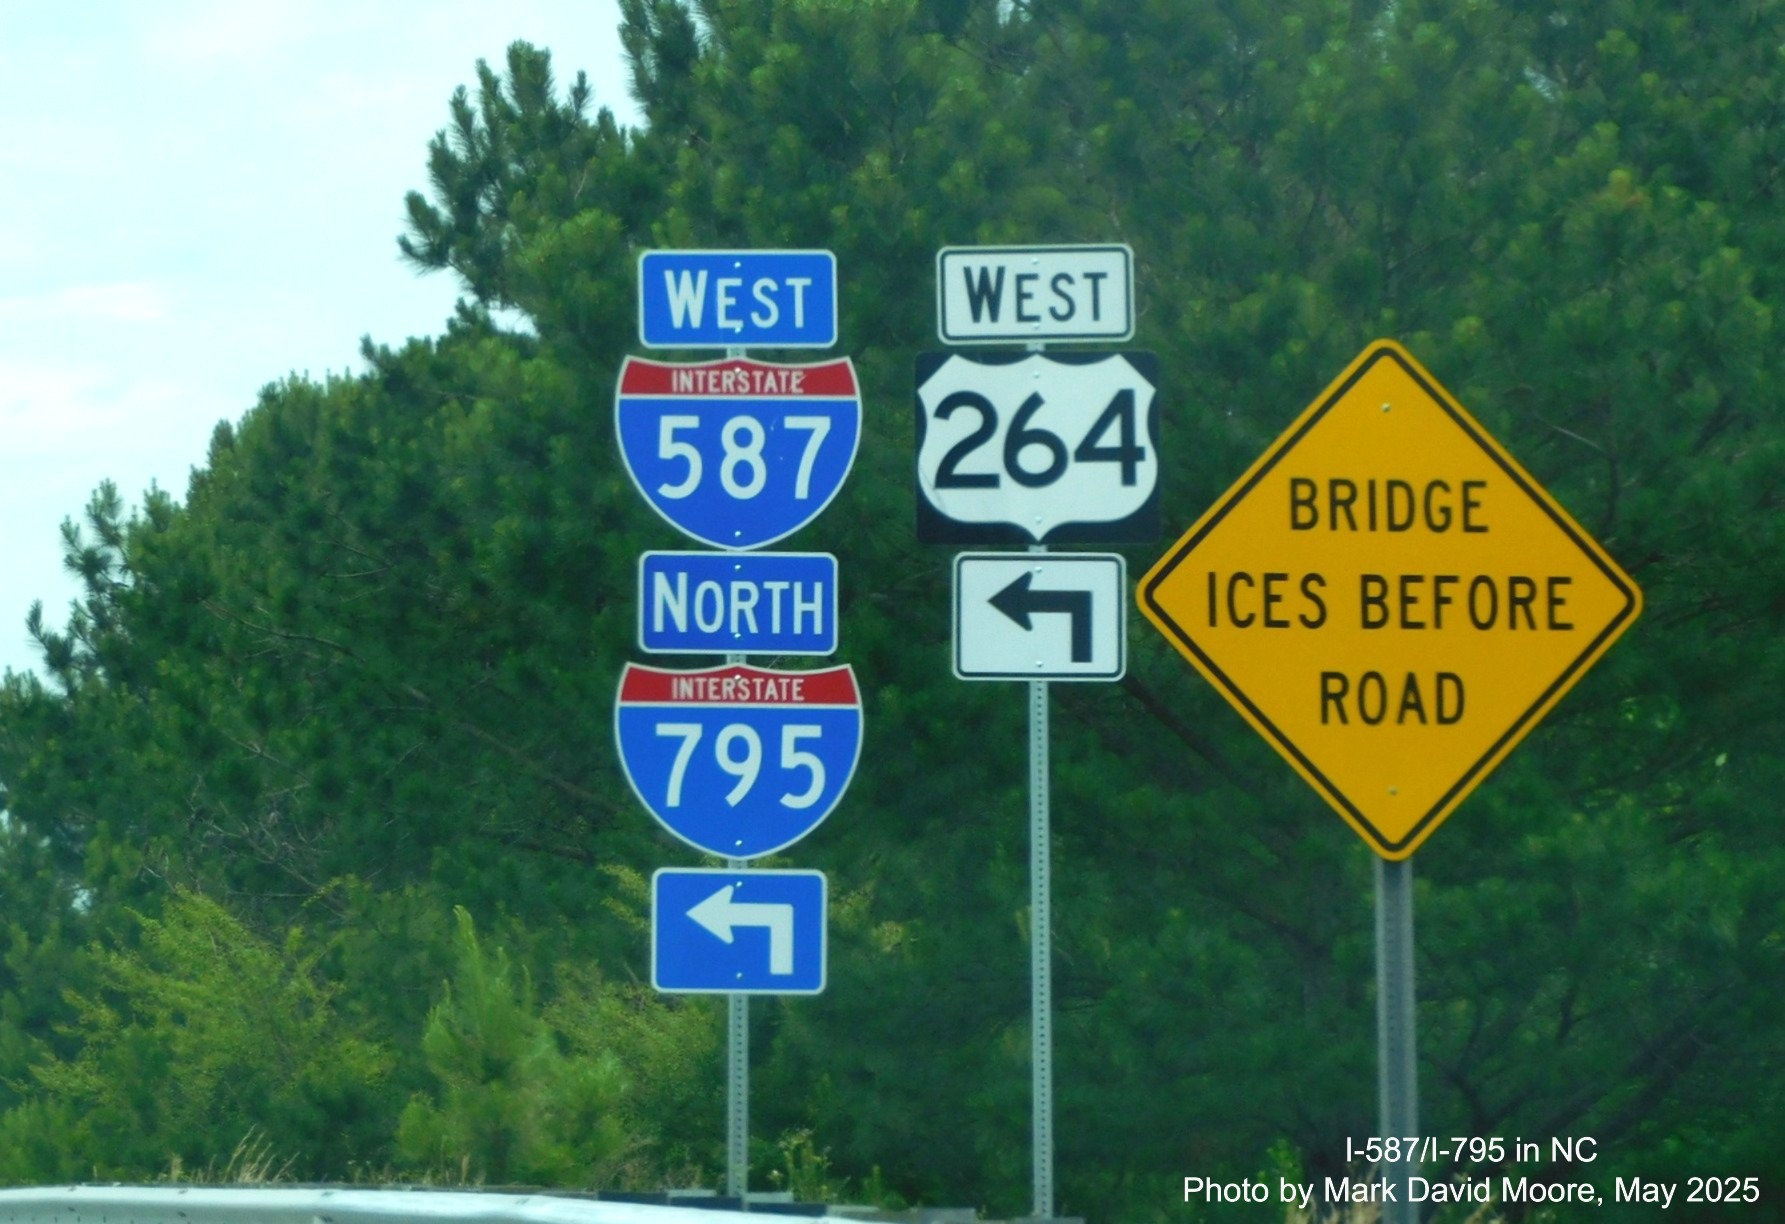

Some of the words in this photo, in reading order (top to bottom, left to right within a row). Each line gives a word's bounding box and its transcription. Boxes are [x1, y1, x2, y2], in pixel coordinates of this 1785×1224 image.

[664, 269, 812, 329] WEST
[963, 266, 1108, 324] WEST
[671, 369, 804, 394] INTERSTATE
[657, 415, 831, 500] 587
[933, 388, 1146, 490] 264
[1289, 477, 1489, 533] BRIDGE
[653, 572, 823, 636] NORTH
[1208, 571, 1328, 629] ICES
[1360, 573, 1575, 632] BEFORE
[671, 677, 805, 702] INTERSTATE
[1320, 670, 1466, 726] ROAD
[655, 723, 826, 809] 795
